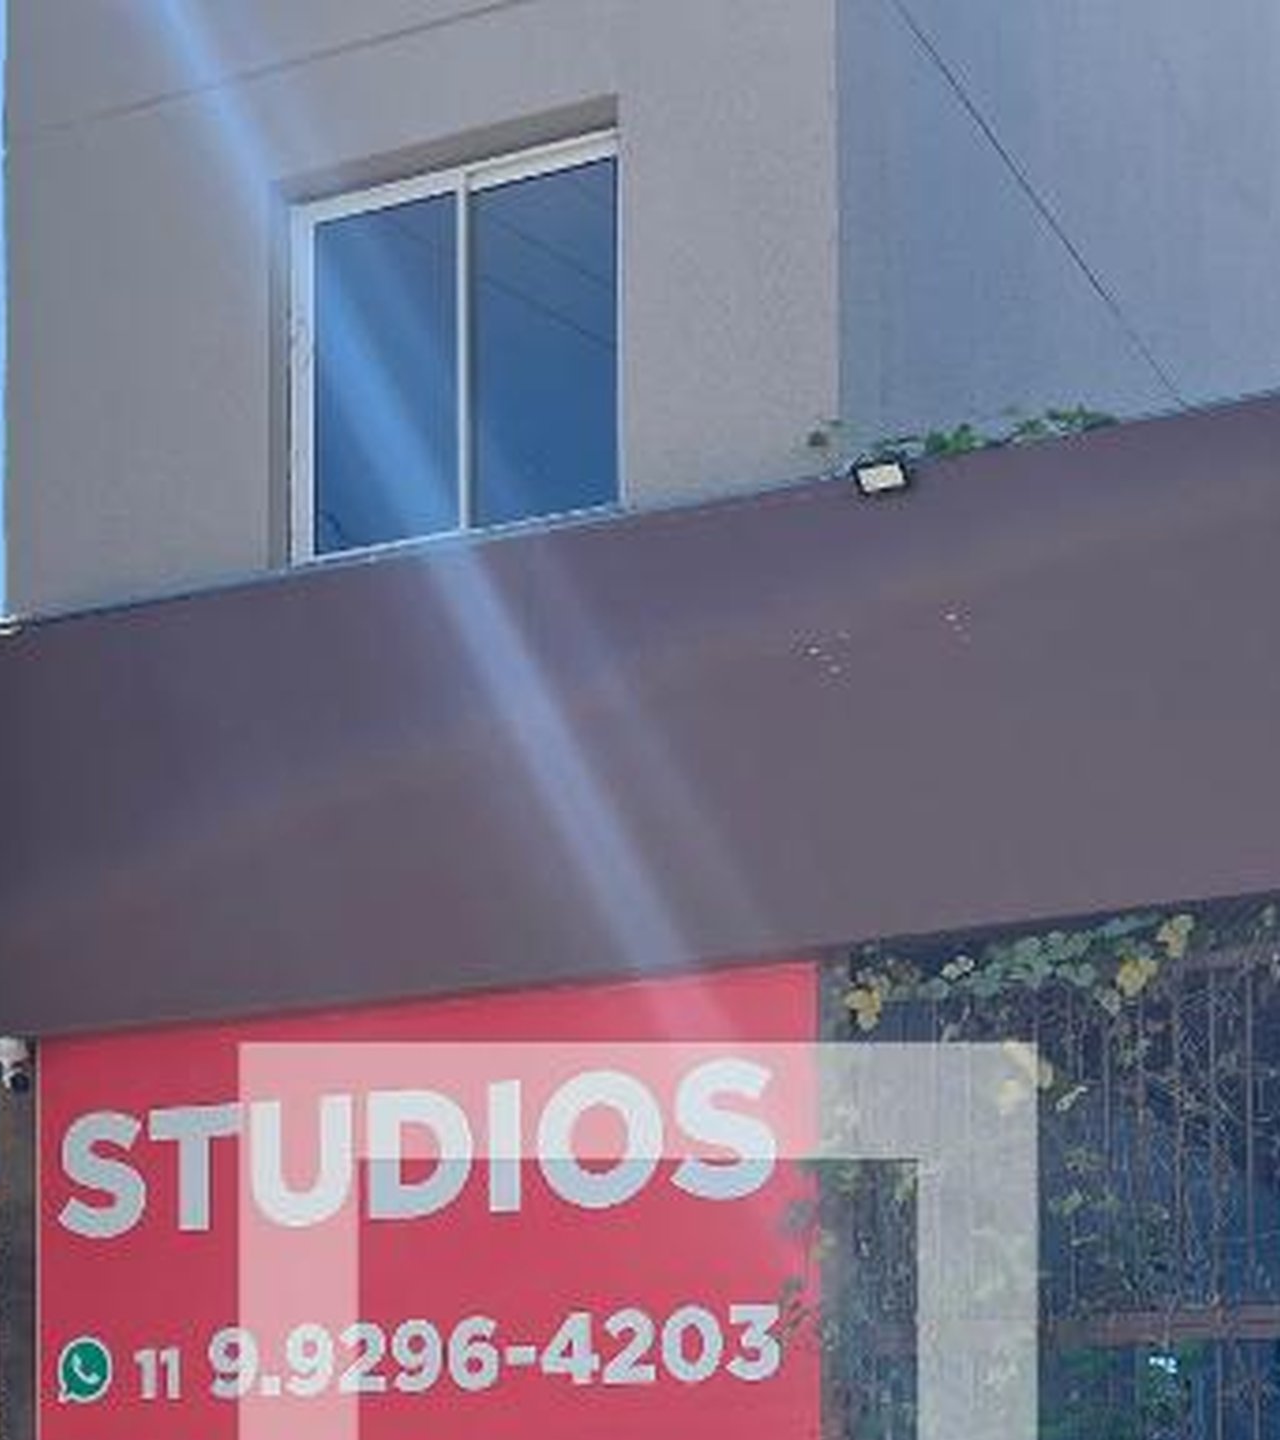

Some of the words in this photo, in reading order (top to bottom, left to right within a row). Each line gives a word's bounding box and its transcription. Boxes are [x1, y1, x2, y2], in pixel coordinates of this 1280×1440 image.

[57, 1058, 778, 1239] STUDIOS
[134, 1348, 182, 1400] 11
[207, 1304, 782, 1400] 9.9296-4203
